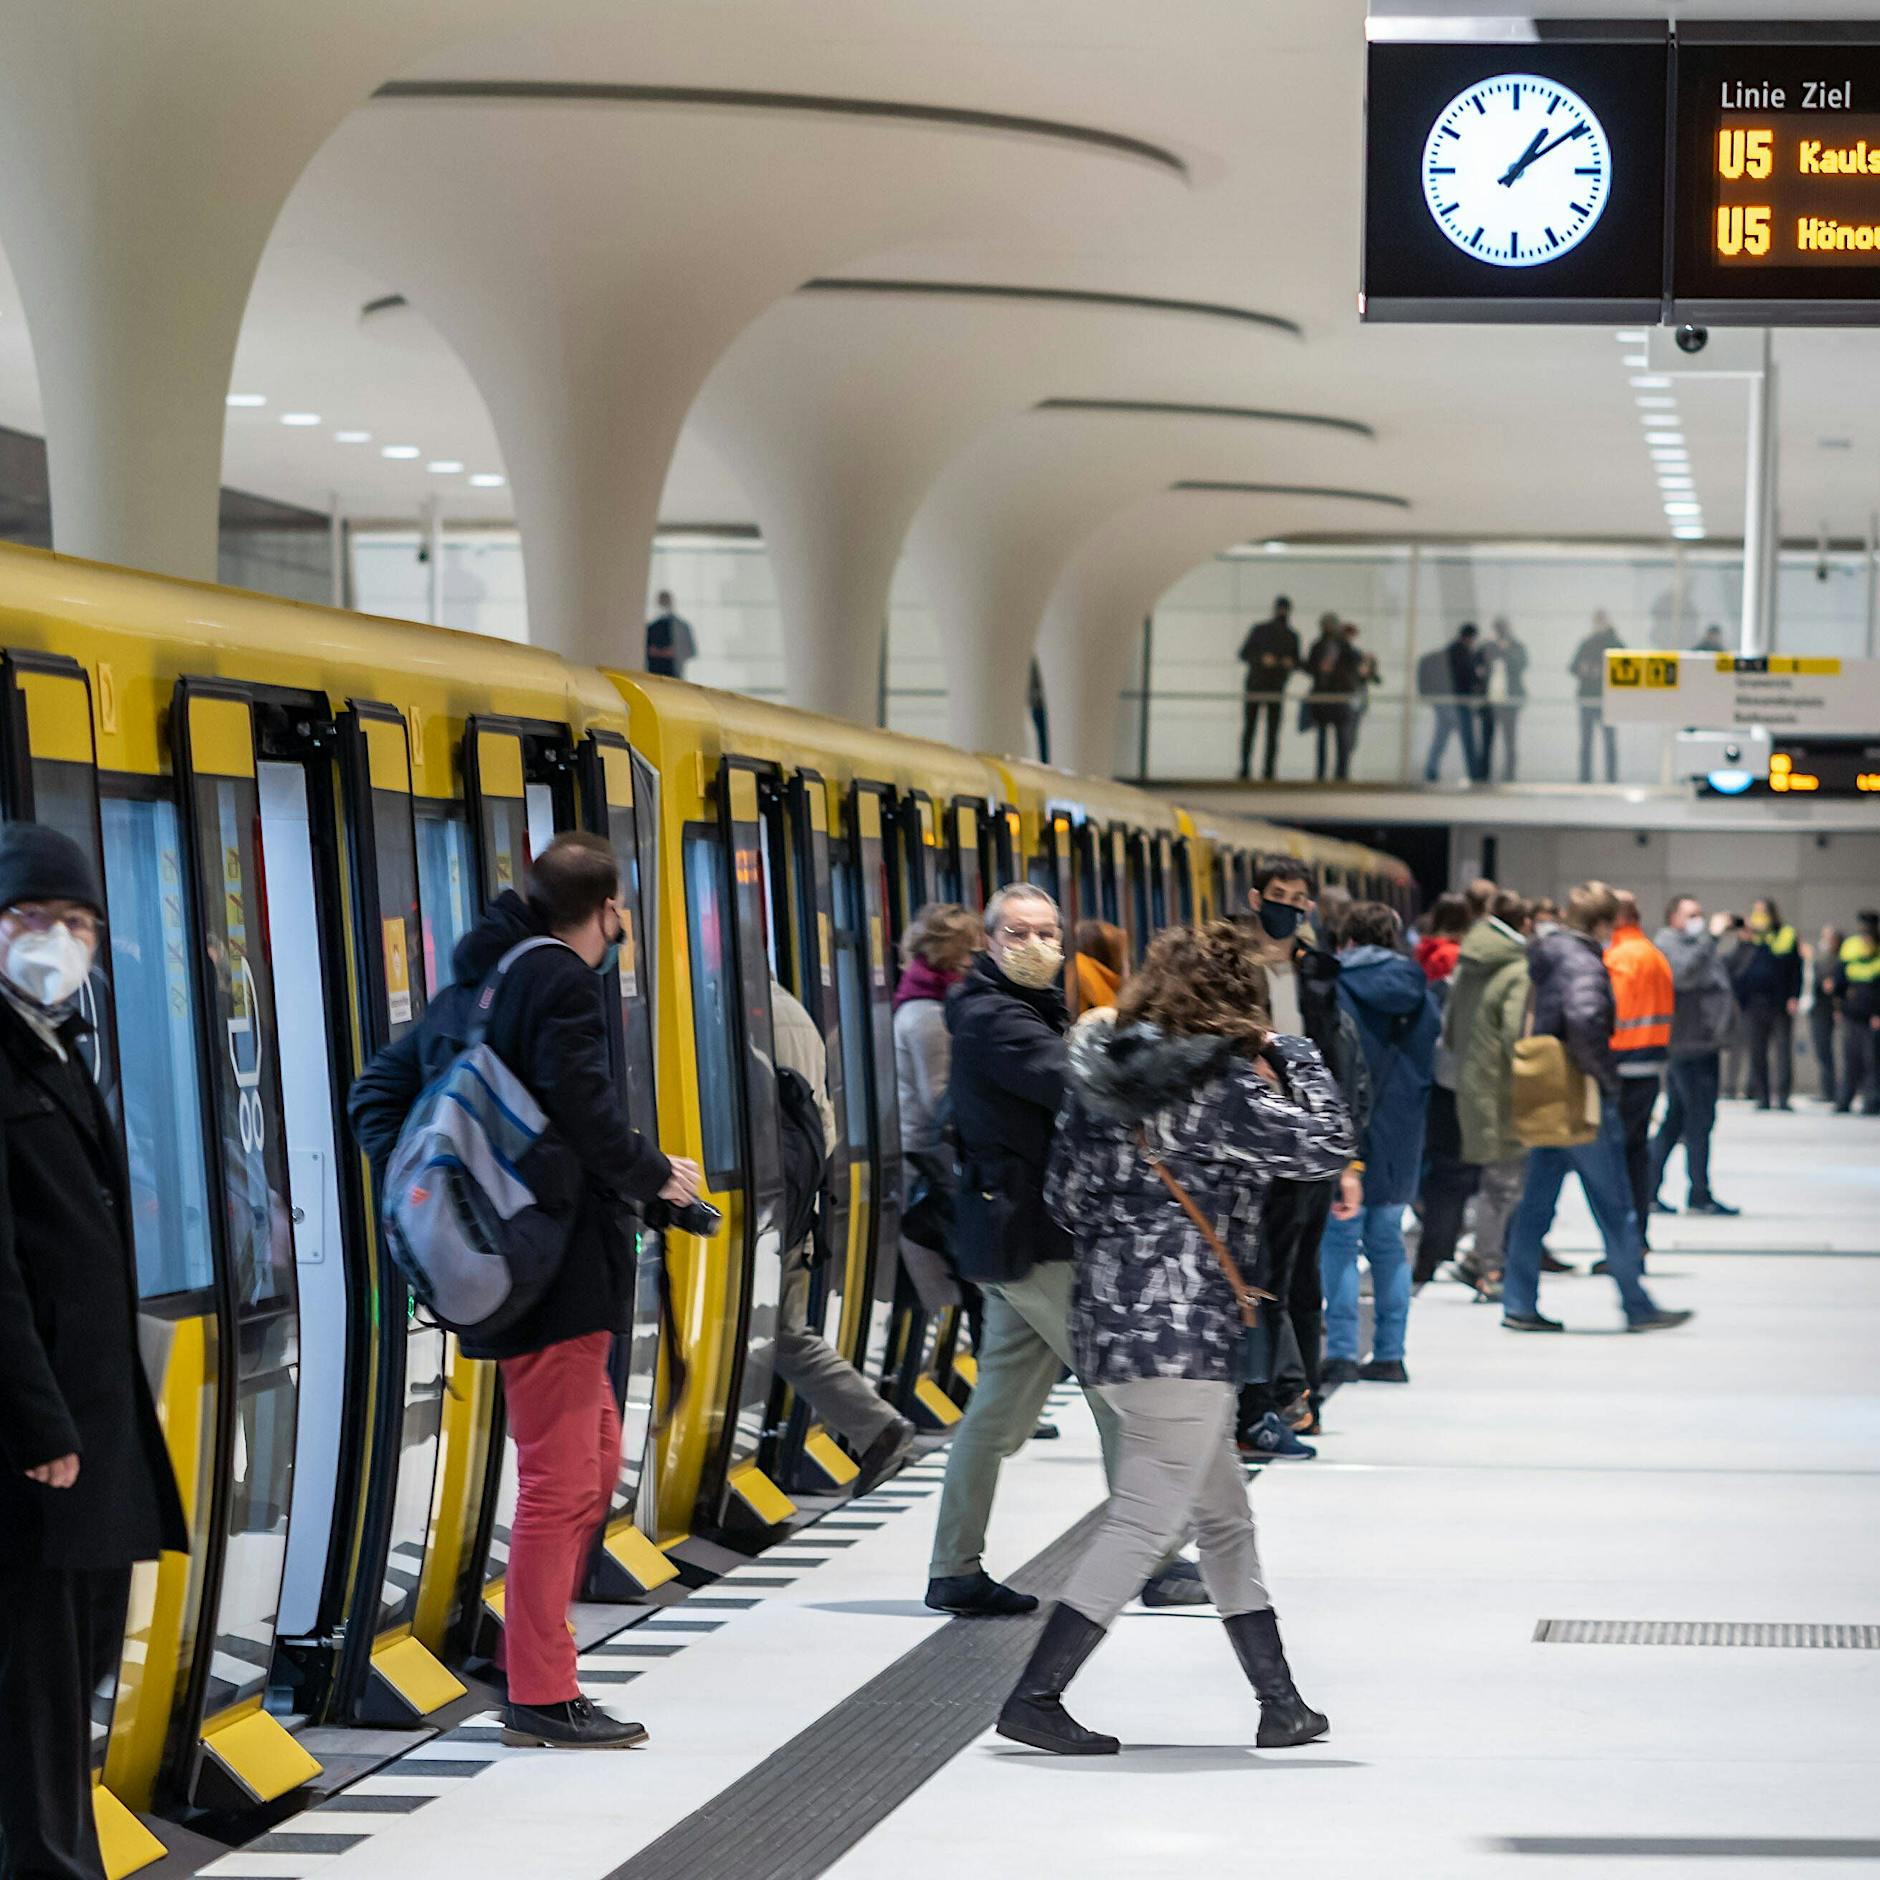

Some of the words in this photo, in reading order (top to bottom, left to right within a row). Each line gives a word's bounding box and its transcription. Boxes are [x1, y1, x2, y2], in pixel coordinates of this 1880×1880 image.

[1721, 81, 1786, 108] Linie
[1801, 80, 1851, 108] Ziel
[1718, 129, 1773, 178] U5
[1799, 139, 1880, 174] Kauls
[1717, 206, 1771, 255] U5
